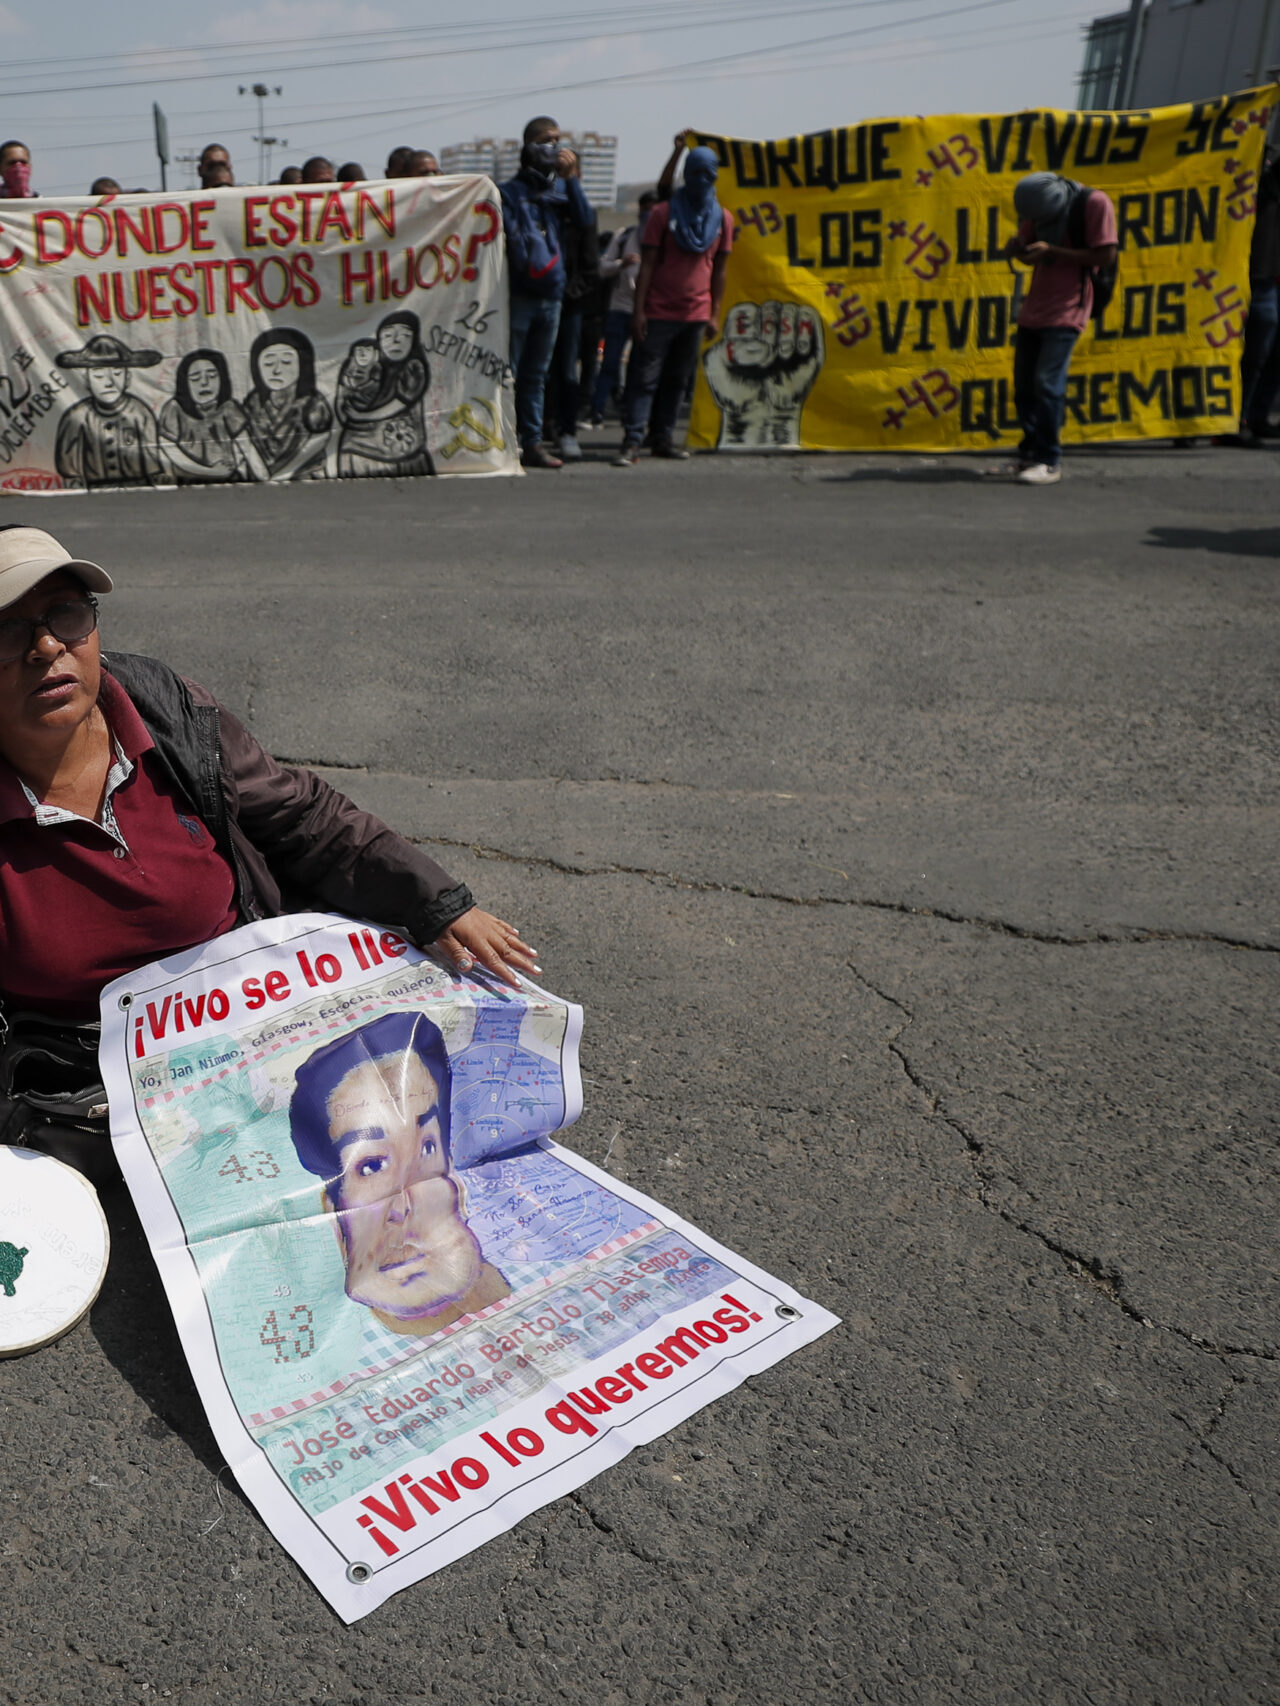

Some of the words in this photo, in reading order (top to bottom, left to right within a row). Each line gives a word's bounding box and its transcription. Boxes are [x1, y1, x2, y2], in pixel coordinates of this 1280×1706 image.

[916, 134, 980, 188] +43
[980, 111, 1150, 174] VIVOS
[1176, 92, 1256, 157] SE
[243, 181, 396, 248] ESTÁN
[786, 209, 882, 268] LOS
[957, 186, 1220, 265] LLRON
[888, 218, 952, 282] +43
[74, 252, 322, 327] NUESTROS
[454, 300, 499, 334] 26
[825, 281, 872, 348] +43
[1192, 267, 1247, 349] +43
[423, 324, 514, 390] SEPTIEMBRE
[882, 368, 961, 431] +43
[960, 366, 1234, 440] QUREMOS
[135, 988, 230, 1059] ¡Vivo
[241, 970, 292, 1010] se
[296, 949, 343, 988] lo
[140, 1075, 162, 1090] Yo,
[170, 1064, 194, 1080] Jan
[198, 1048, 245, 1071] Nimmo,
[251, 1019, 313, 1048] Glasgow,
[387, 974, 434, 999] quiero
[490, 1092, 498, 1103] 8
[490, 1127, 498, 1138] 9
[218, 1150, 281, 1184] 43
[272, 1284, 291, 1298] 43
[282, 1416, 356, 1465] José
[362, 1363, 475, 1425] Eduardo
[479, 1304, 582, 1364] Bartolo
[582, 1246, 692, 1301] Tlatempa
[299, 1458, 344, 1487] Hijo
[349, 1444, 371, 1461] de
[450, 1396, 464, 1410] y
[515, 1352, 537, 1370] de
[595, 1309, 616, 1326] 18
[617, 1289, 651, 1312] años
[355, 1455, 490, 1557] ¡Vivo
[479, 1427, 545, 1469] lo
[544, 1292, 764, 1440] queremos!
